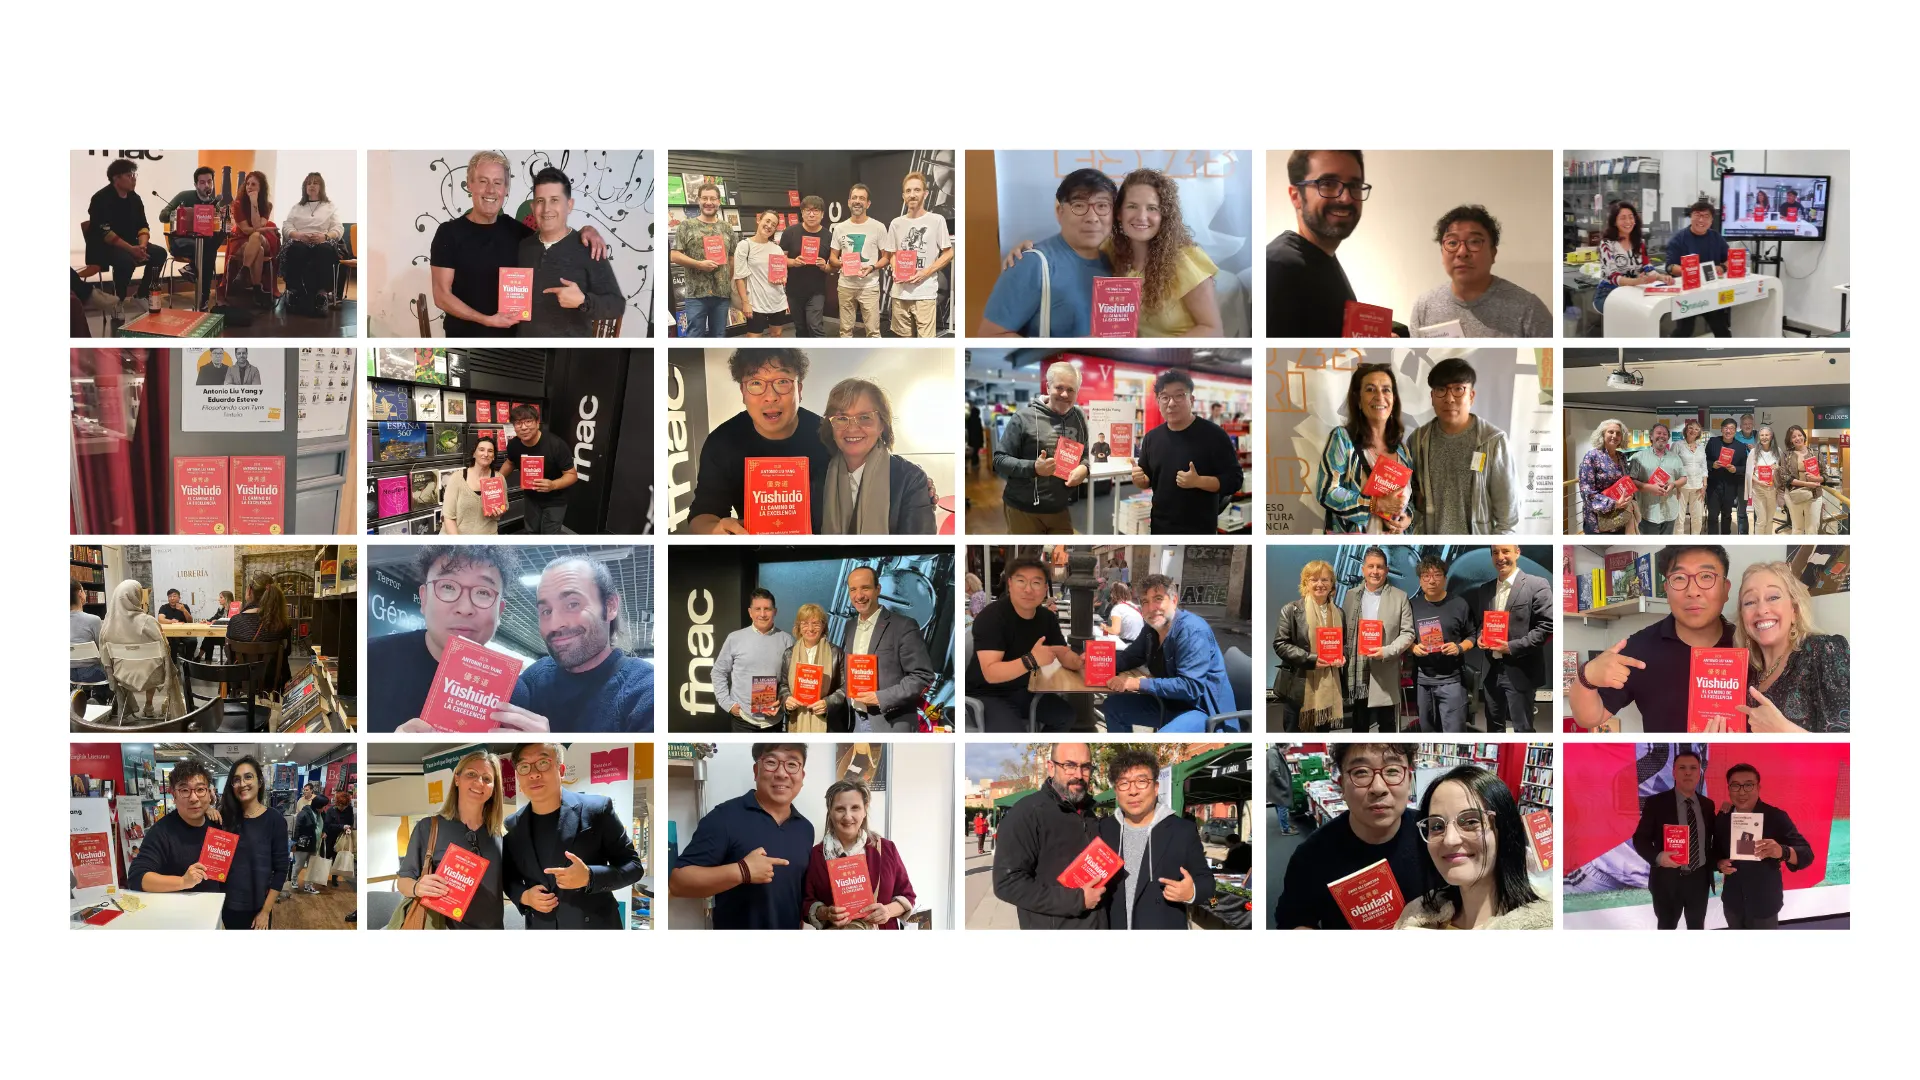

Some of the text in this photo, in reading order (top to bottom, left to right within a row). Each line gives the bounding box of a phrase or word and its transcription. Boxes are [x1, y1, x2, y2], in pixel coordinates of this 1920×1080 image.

[181, 485, 221, 495] Yūshūdō
[235, 484, 278, 495] Yūshūdō
[752, 490, 803, 504] Yūshūdō
[1266, 503, 1284, 512] ESO
[1267, 513, 1294, 521] TURA
[1266, 522, 1290, 531] NCIA
[177, 568, 209, 578] LIBRERÍA
[376, 570, 401, 590] Terror
[679, 588, 715, 716] fnac
[461, 656, 482, 668] ANTONIO
[490, 666, 503, 674] YANG
[1696, 676, 1739, 690] Yūshūdō
[443, 676, 501, 709] Yūshūdō
[455, 699, 479, 712] CAMINO
[452, 705, 486, 720] EXCELENCIA
[835, 875, 866, 887] Yūshūdō
